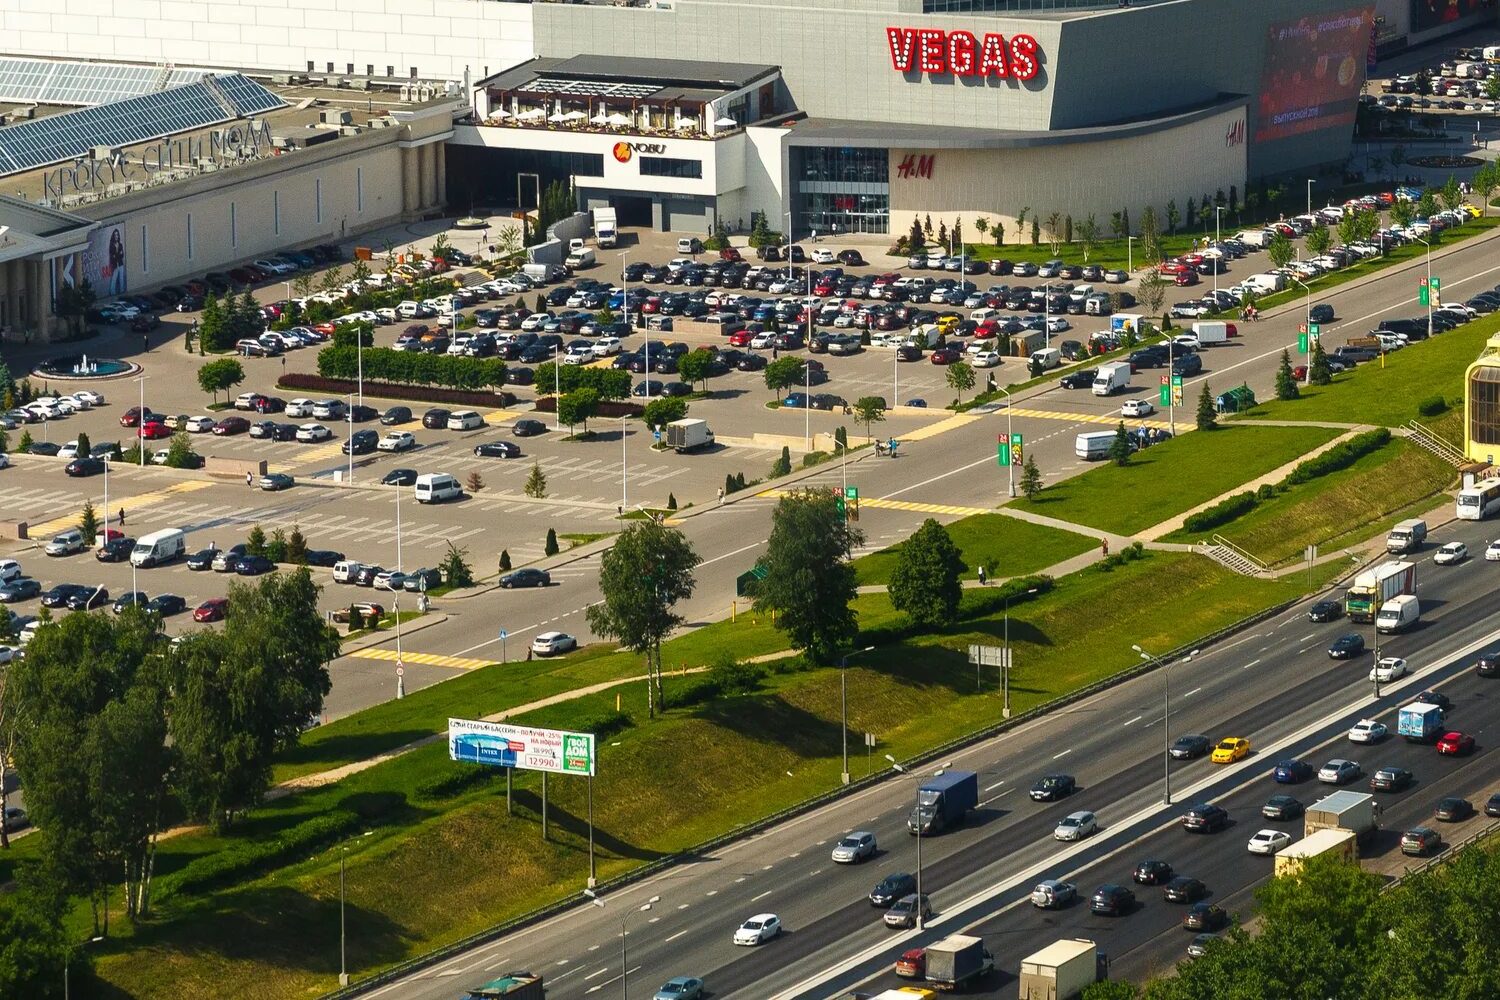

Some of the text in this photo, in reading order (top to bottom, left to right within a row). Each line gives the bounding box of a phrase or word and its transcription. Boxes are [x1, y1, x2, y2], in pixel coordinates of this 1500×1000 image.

[886, 27, 1039, 80] VEGAS
[626, 142, 667, 154] NOBU
[43, 151, 135, 198] КРОКУС
[898, 154, 935, 180] H&M
[491, 725, 516, 734] БАССЕЙН
[520, 729, 544, 738] ПОЛУЧИ
[565, 746, 588, 757] ДОМ
